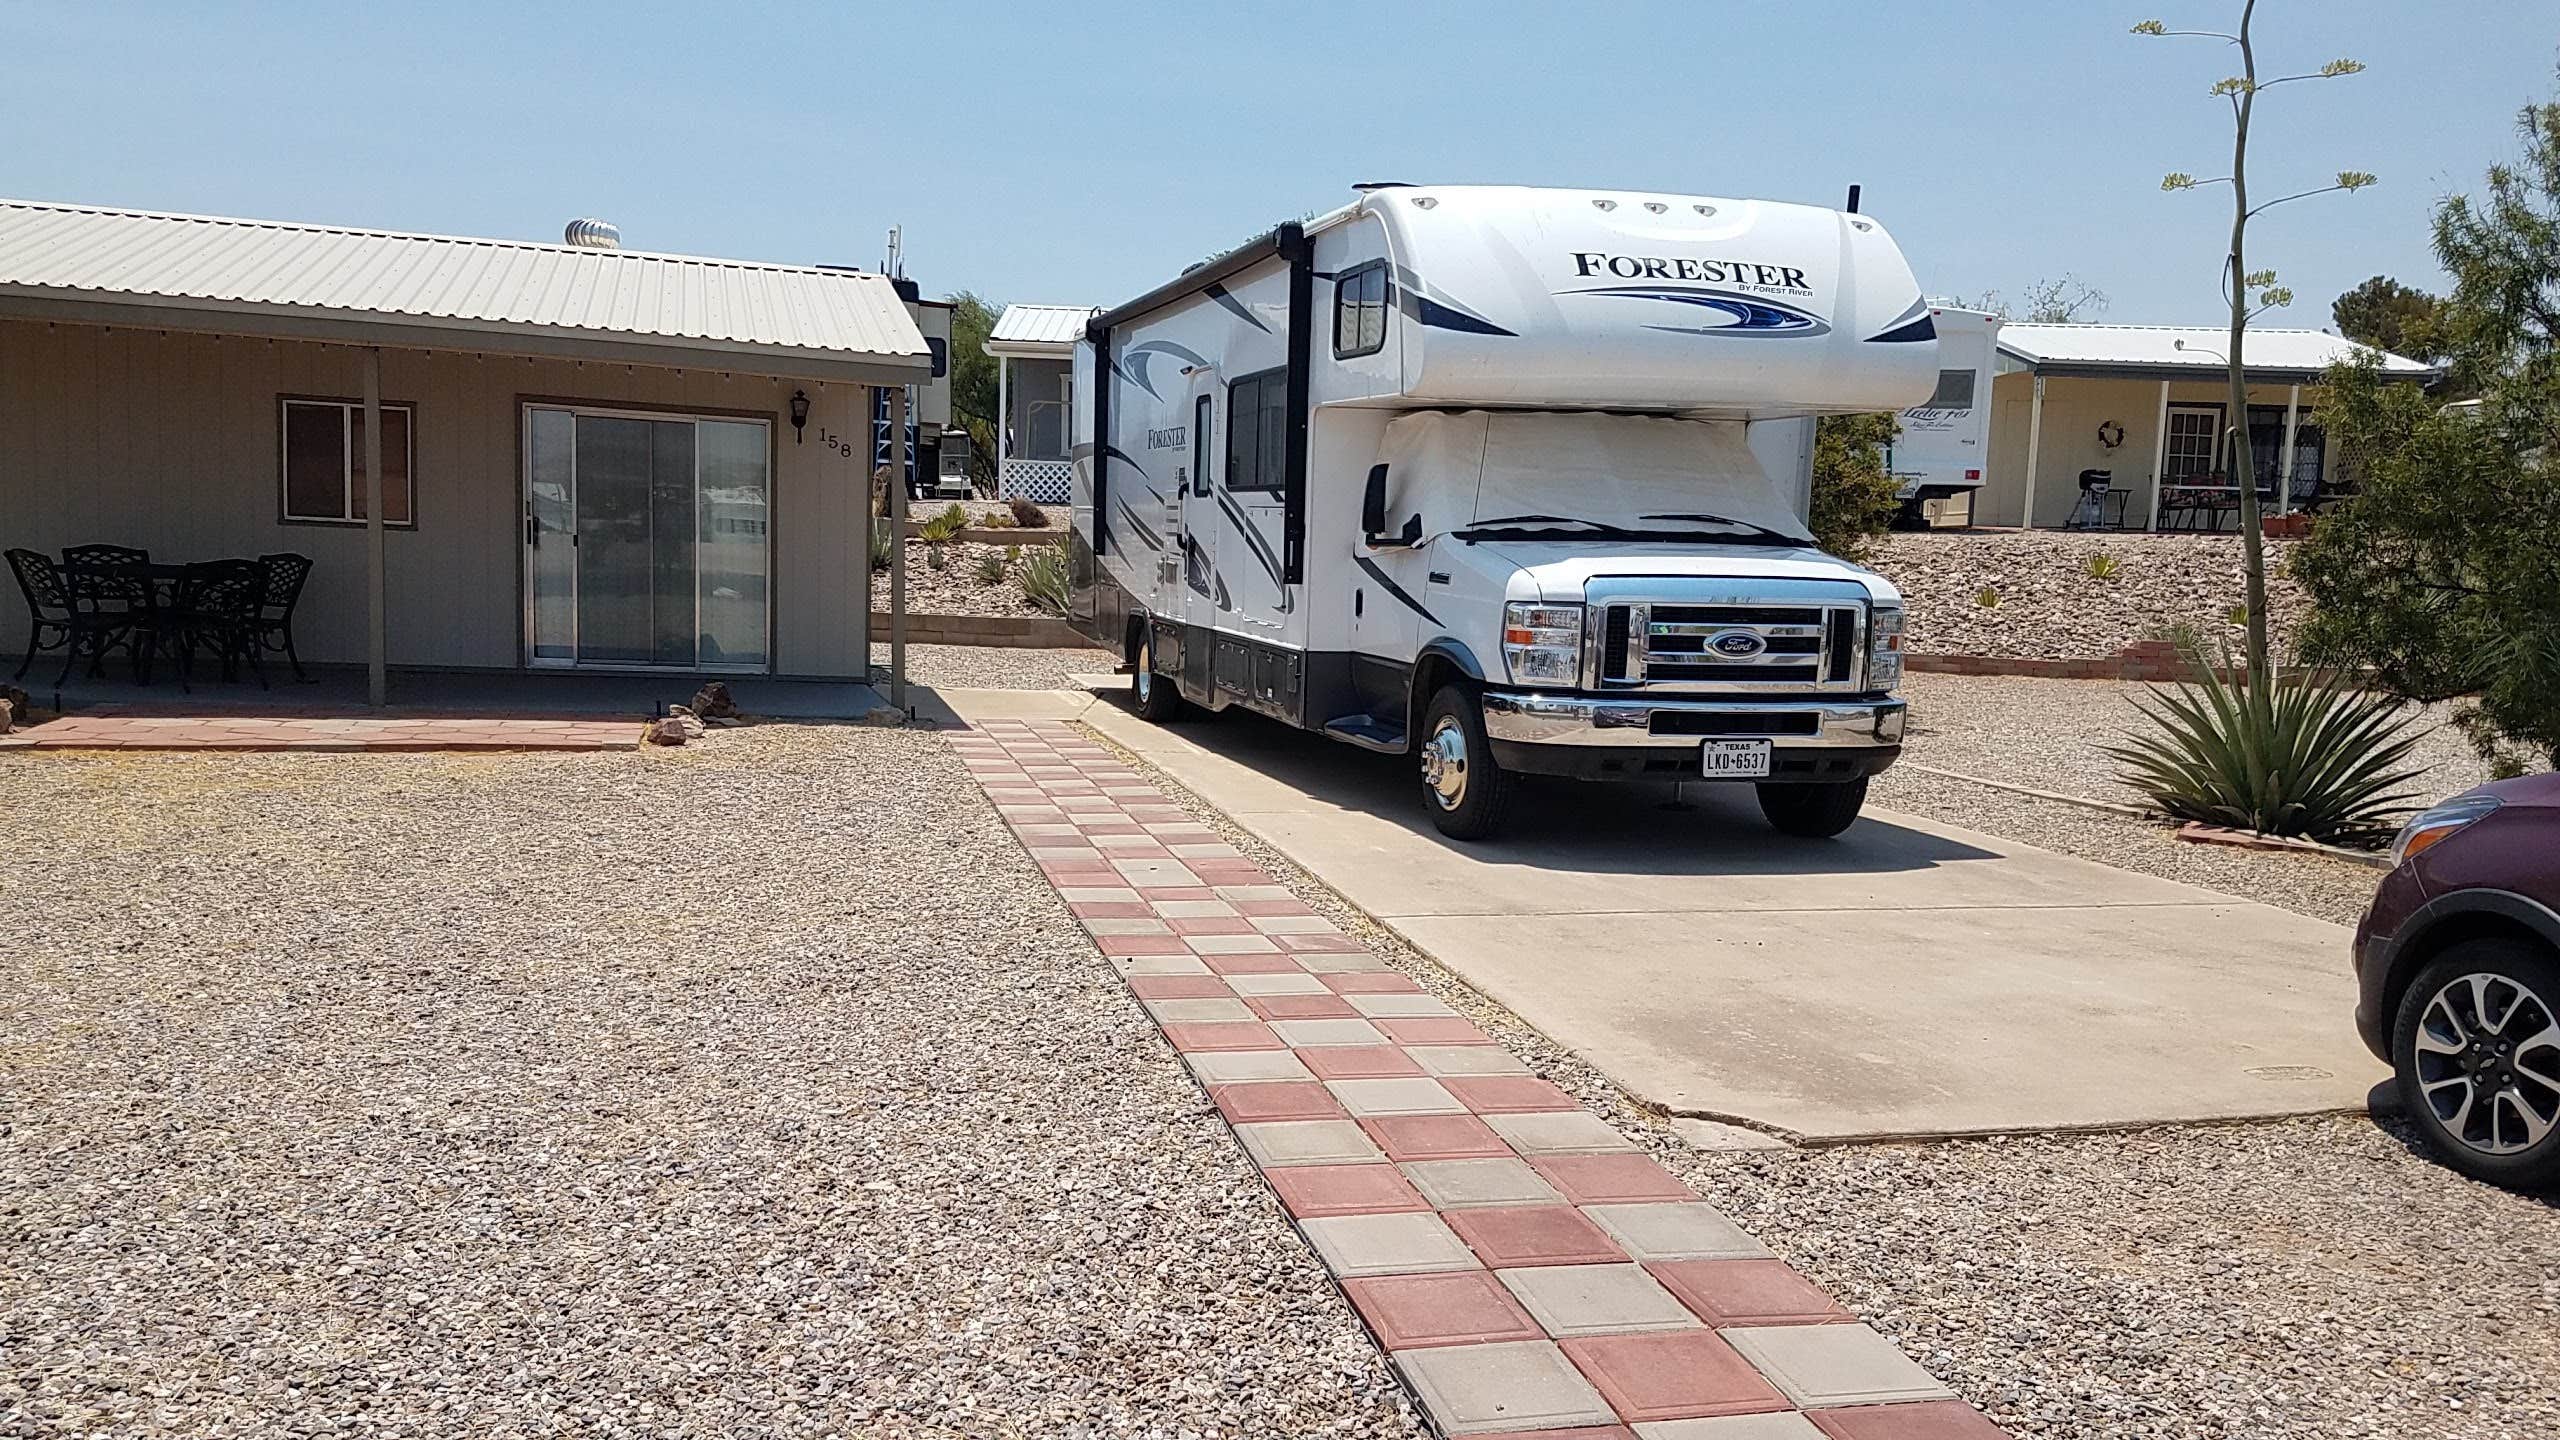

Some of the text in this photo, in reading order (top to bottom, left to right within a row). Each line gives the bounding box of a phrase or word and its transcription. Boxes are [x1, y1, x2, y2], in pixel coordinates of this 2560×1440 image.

[1569, 252, 1812, 290] FORESTER
[1753, 285, 1786, 294] FOREST
[1788, 288, 1813, 297] RIVER
[819, 427, 852, 458] 158
[1147, 426, 1186, 450] FORESTER
[1724, 638, 1753, 651] Ford
[1725, 743, 1751, 751] TEXAS
